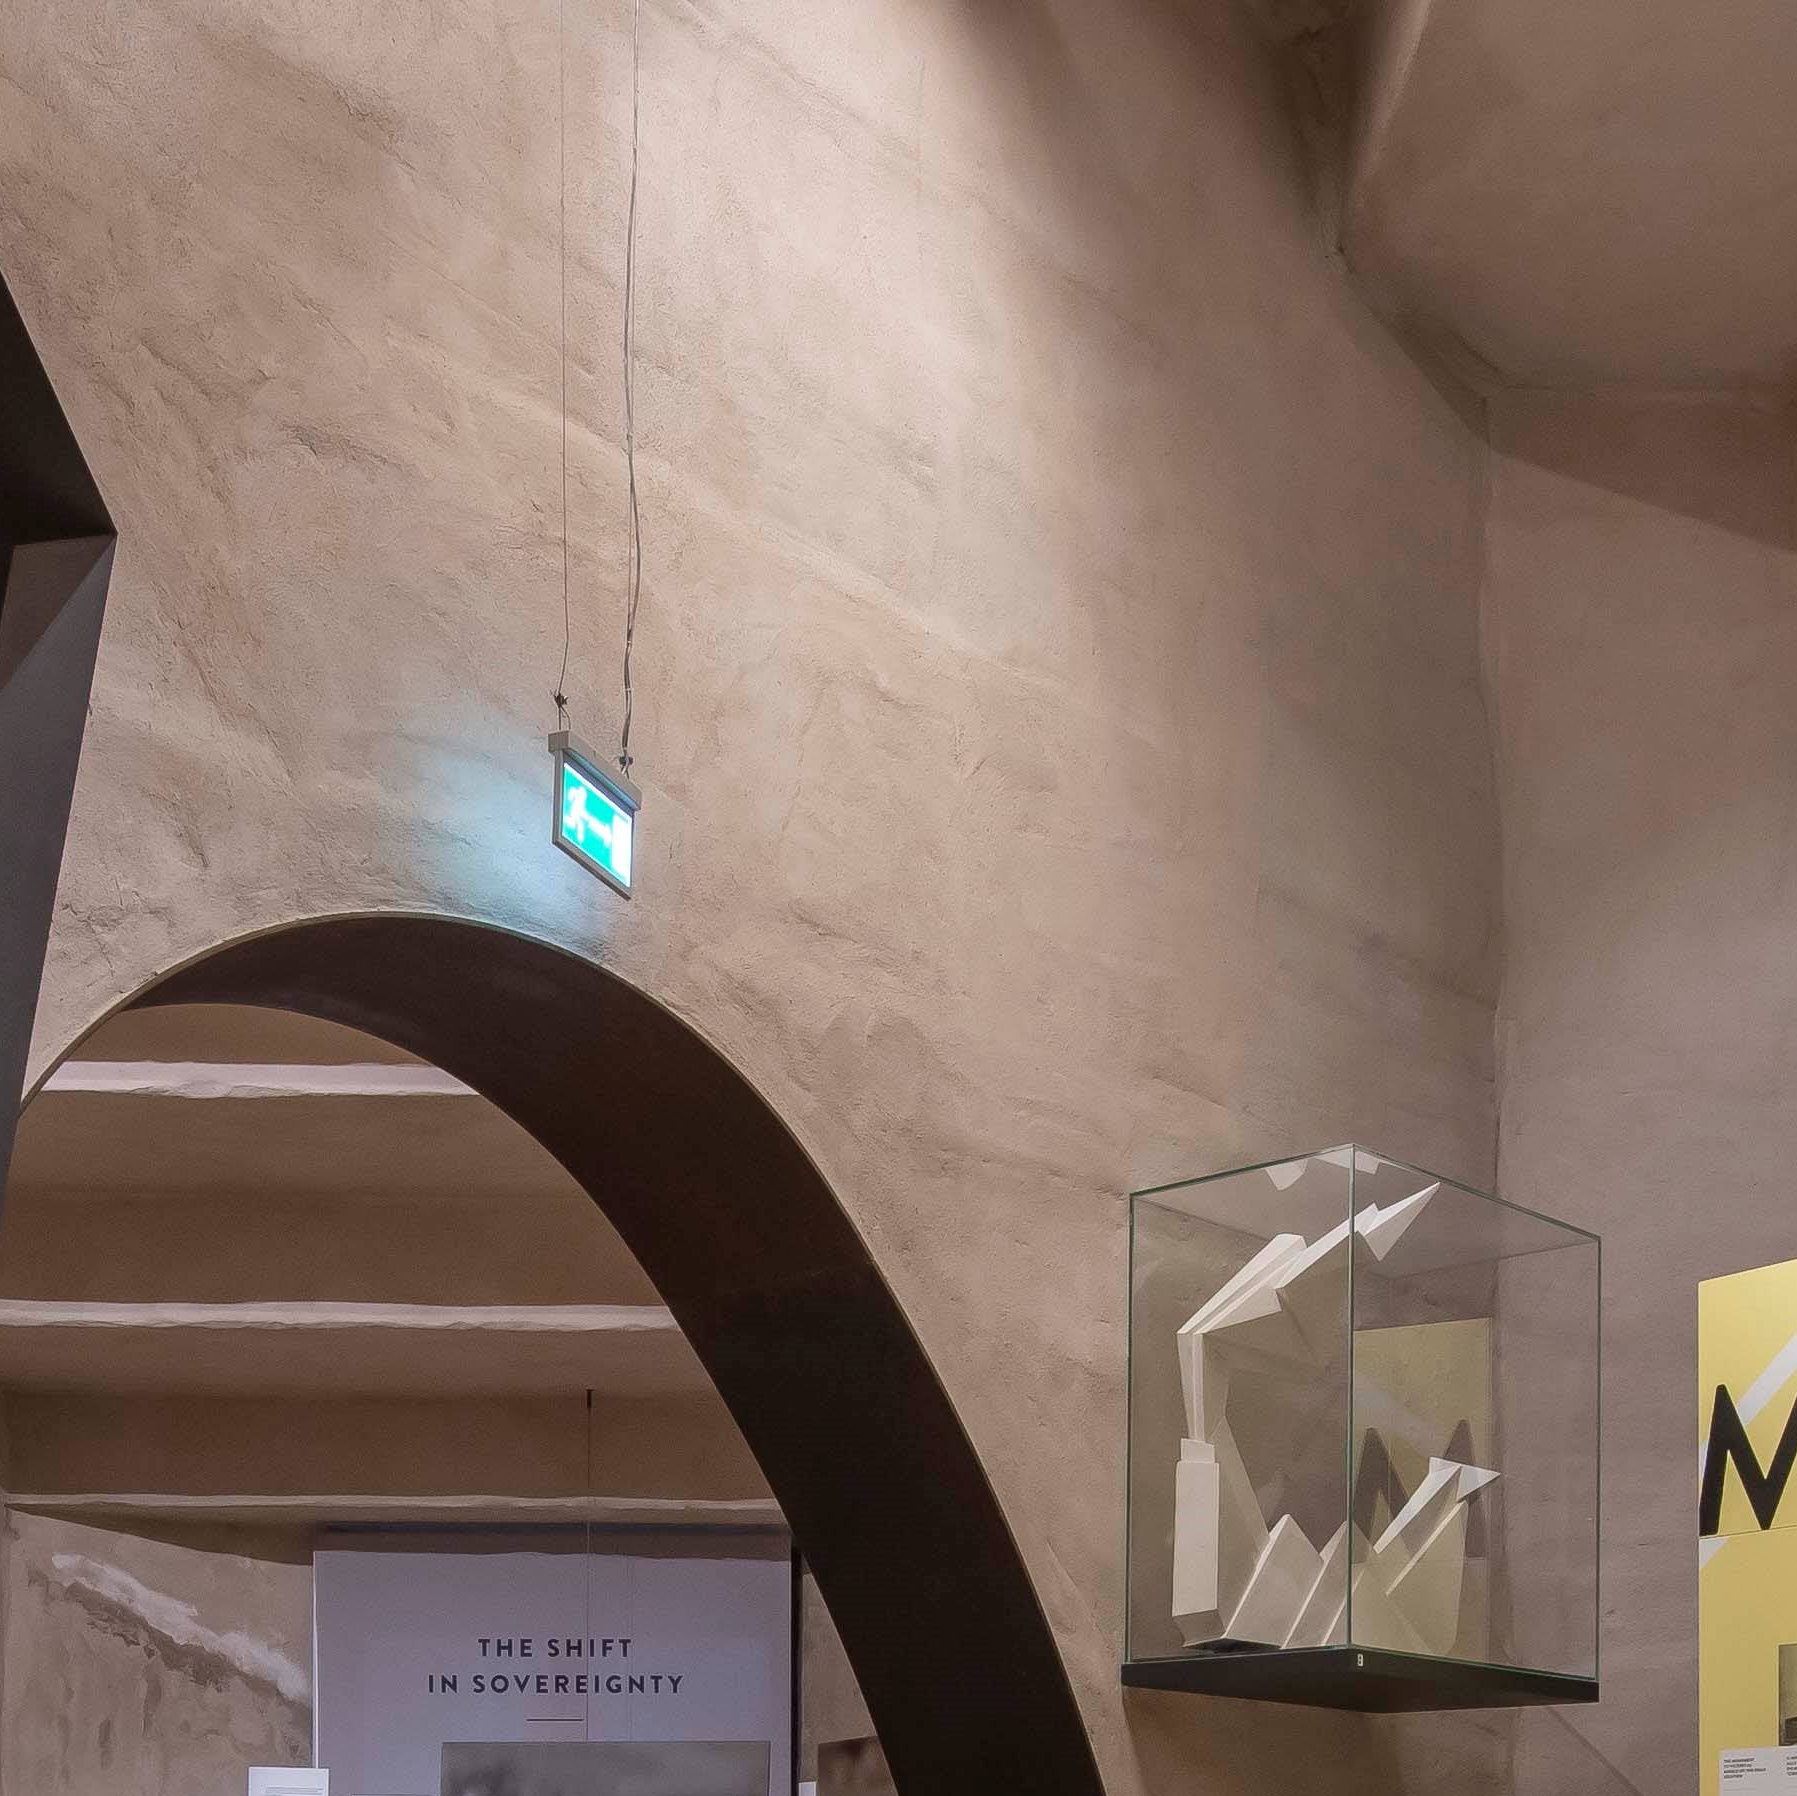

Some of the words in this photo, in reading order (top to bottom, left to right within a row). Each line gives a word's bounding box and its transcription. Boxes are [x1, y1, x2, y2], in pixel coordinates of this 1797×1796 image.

[478, 1638, 535, 1658] THE
[546, 1637, 633, 1658] SHIFT
[428, 1674, 458, 1695] IN
[471, 1673, 685, 1696] SOVEREIGNTY
